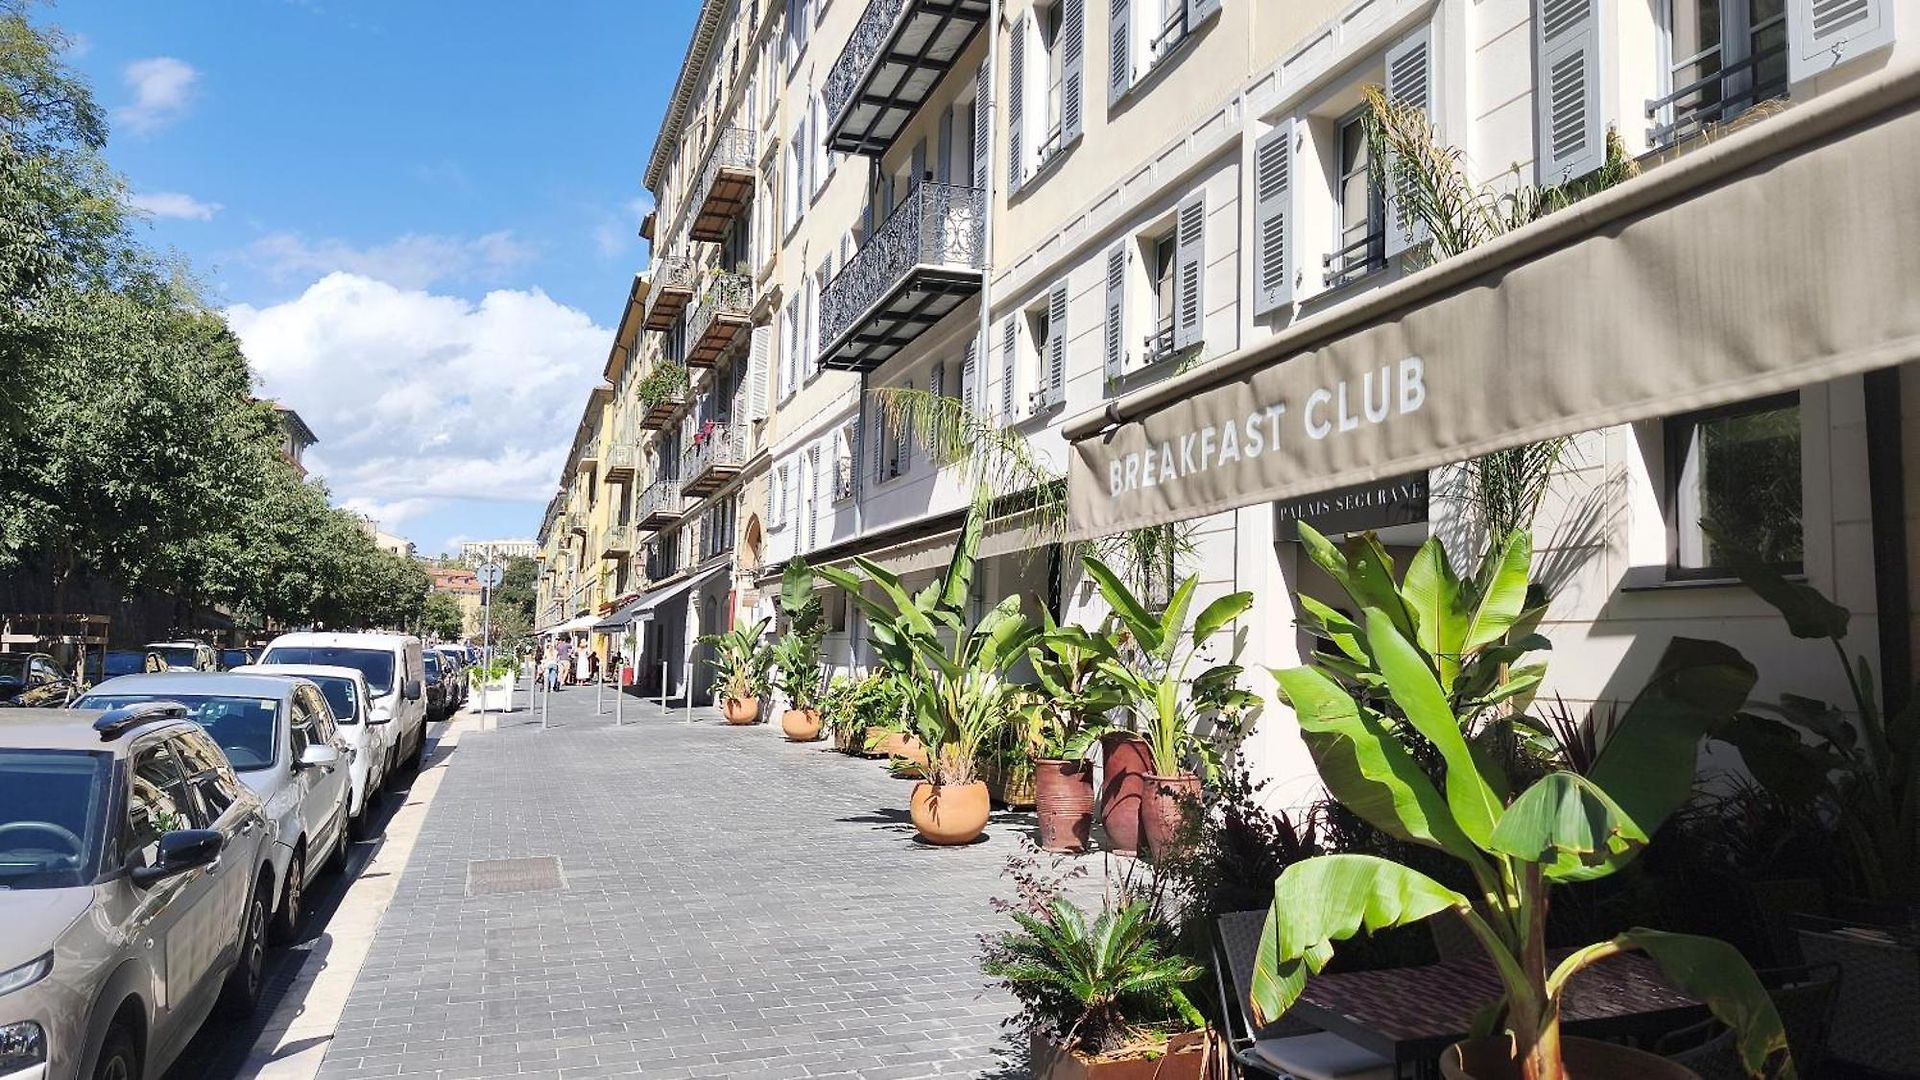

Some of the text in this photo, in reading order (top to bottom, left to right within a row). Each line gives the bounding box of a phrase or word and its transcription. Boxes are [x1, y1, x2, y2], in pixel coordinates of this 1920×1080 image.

[1109, 356, 1427, 498] BREAKFAST CLUB
[1279, 481, 1423, 521] PALAIS SEGURANE
